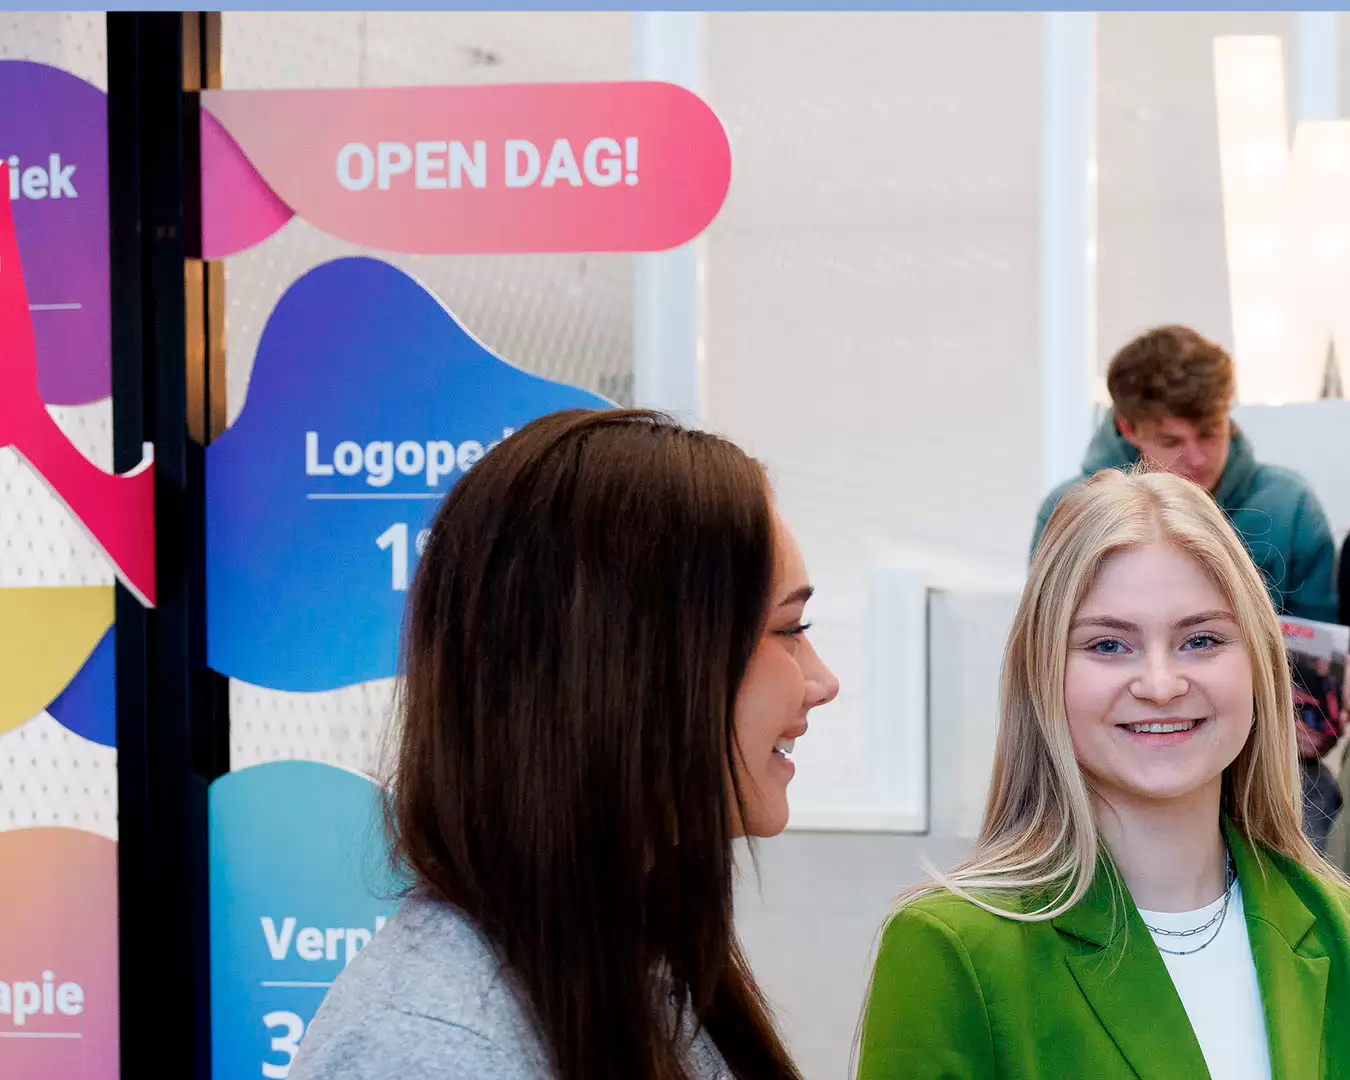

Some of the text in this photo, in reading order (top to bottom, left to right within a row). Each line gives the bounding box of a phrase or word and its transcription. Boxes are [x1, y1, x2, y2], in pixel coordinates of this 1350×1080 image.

[0, 153, 78, 200] iek
[336, 136, 639, 191] OPEN DAG!
